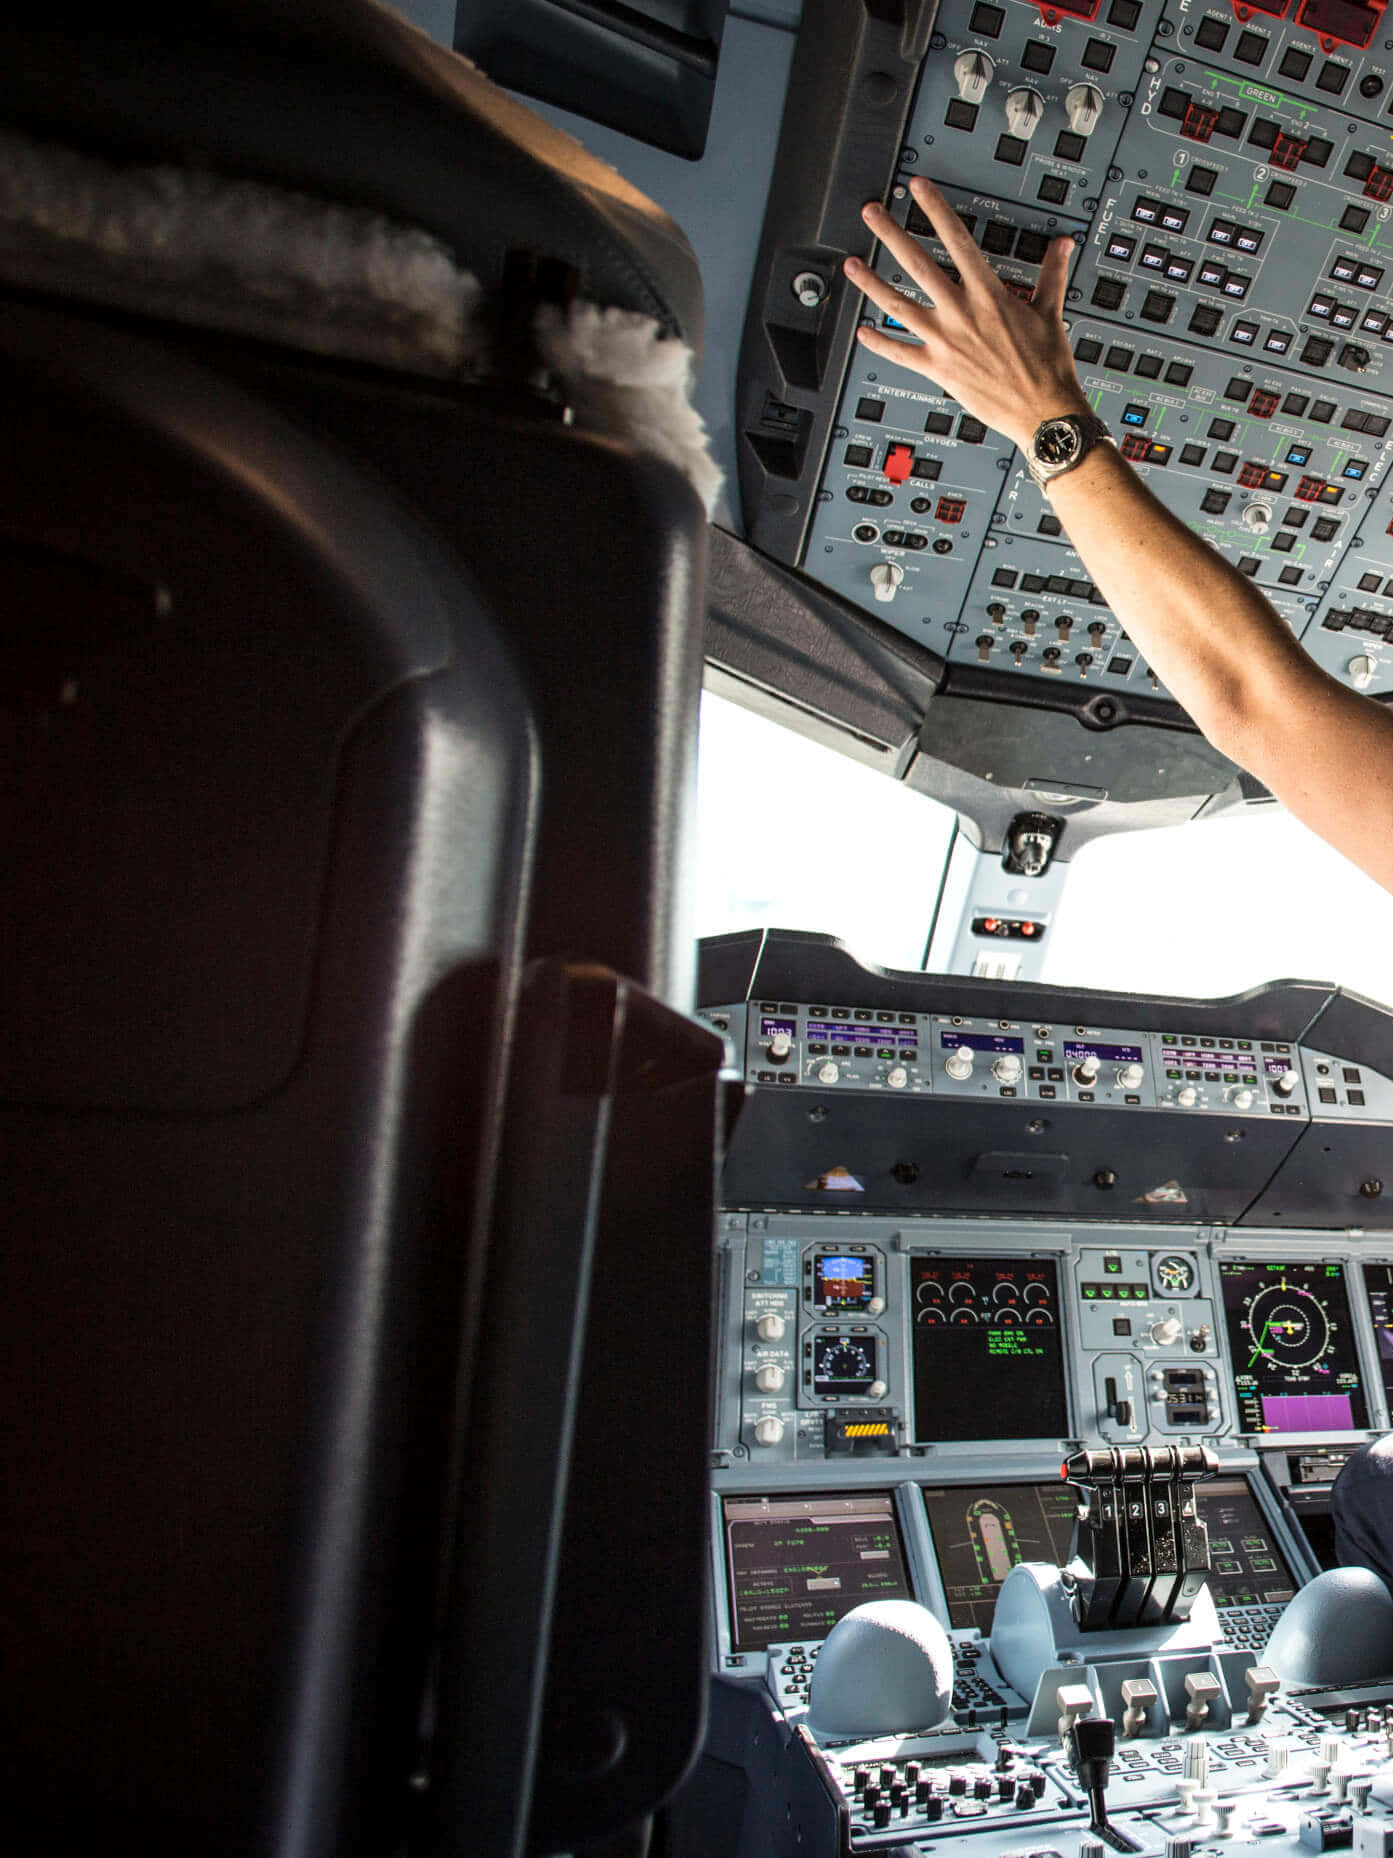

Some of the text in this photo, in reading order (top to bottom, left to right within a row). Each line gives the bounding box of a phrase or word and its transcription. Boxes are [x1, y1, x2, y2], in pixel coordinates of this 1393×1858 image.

[1140, 76, 1161, 115] HYD
[1245, 87, 1276, 103] GREEN
[1257, 167, 1266, 180] 2
[1380, 206, 1389, 219] 3
[1094, 198, 1117, 245] FUEL
[878, 386, 947, 405] ENTERTAINMENT
[924, 437, 957, 449] OXYGEN
[910, 480, 935, 490] CALLS
[1009, 470, 1024, 500] AIR
[880, 548, 905, 557] WIPER
[1325, 541, 1342, 568] AIR
[1105, 1506, 1112, 1518] 1
[1132, 1505, 1140, 1516] 2
[1158, 1503, 1165, 1514] 3
[1184, 1501, 1192, 1513] 4
